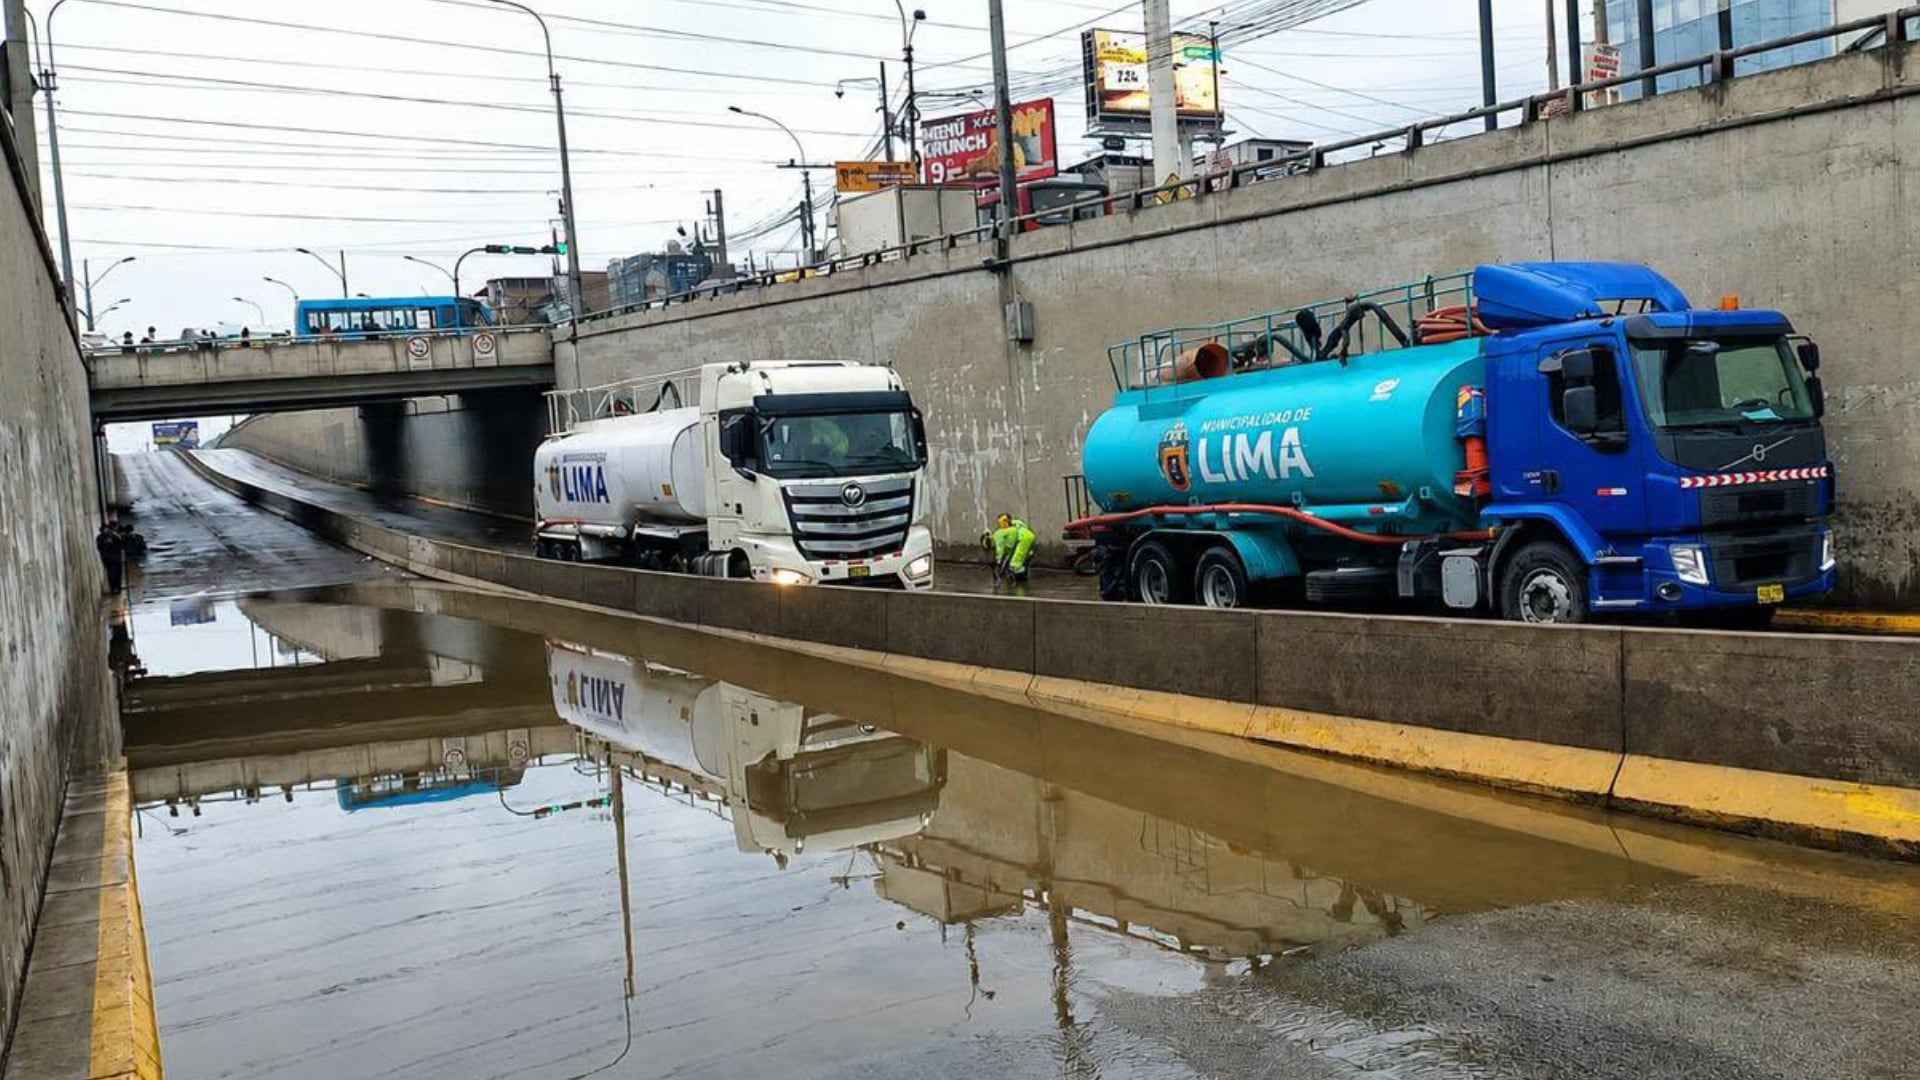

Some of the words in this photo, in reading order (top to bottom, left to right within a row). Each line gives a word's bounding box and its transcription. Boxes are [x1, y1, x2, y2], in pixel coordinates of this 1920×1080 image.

[1202, 408, 1292, 433] MUNICIPALIDAD
[1293, 406, 1313, 422] DE
[1198, 426, 1314, 484] LIMA
[563, 465, 610, 503] LIMA
